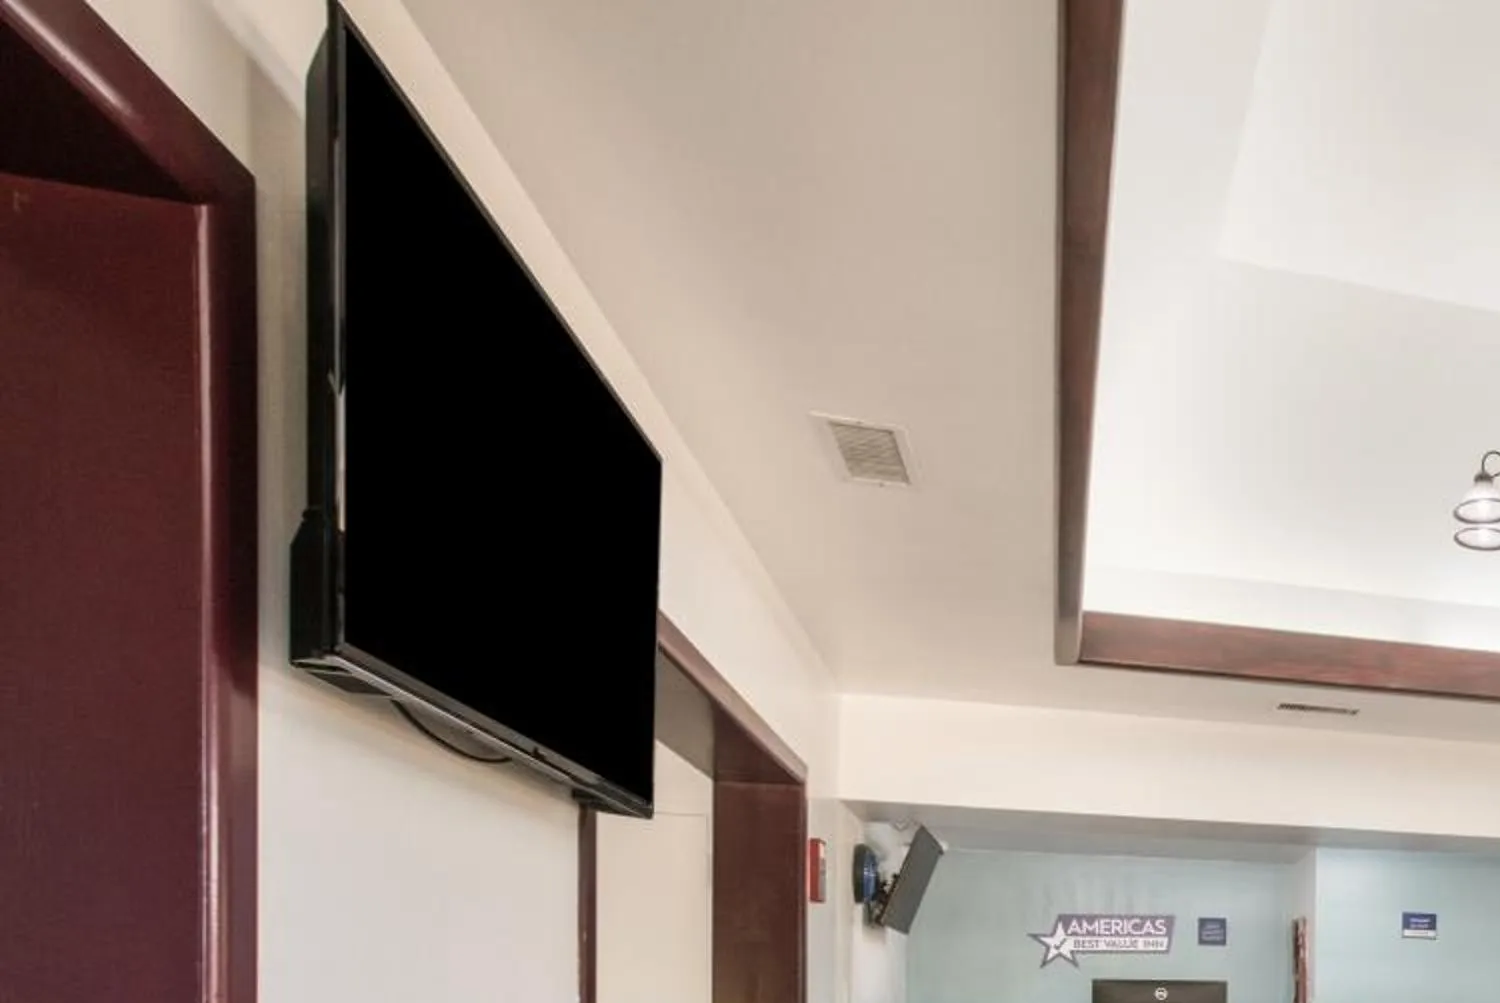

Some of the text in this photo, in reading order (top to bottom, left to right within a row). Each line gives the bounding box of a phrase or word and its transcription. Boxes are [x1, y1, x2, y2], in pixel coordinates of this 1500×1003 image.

[1067, 918, 1167, 935] AMERICAS
[1073, 939, 1164, 949] BEST VALUE INN
